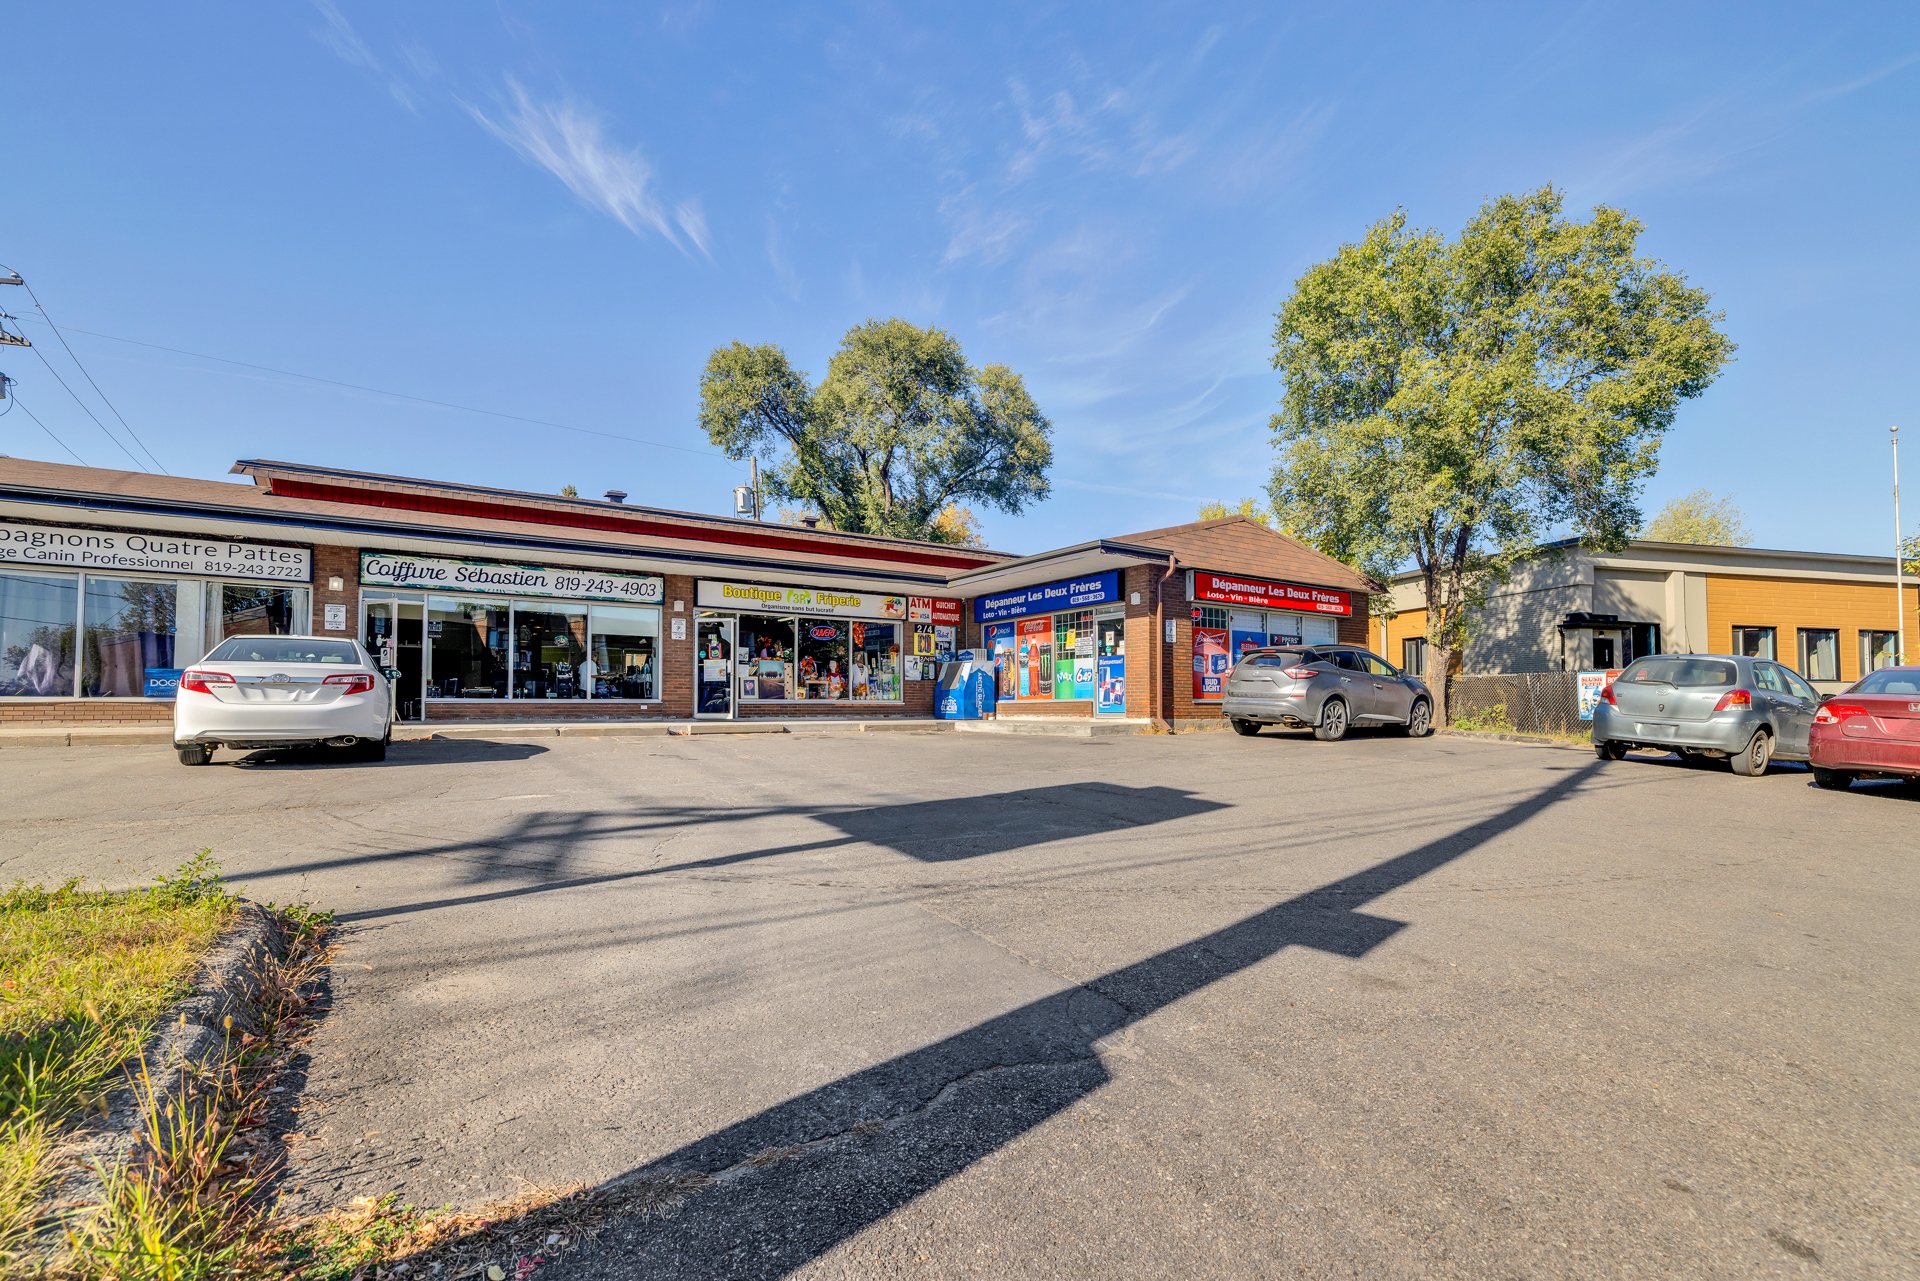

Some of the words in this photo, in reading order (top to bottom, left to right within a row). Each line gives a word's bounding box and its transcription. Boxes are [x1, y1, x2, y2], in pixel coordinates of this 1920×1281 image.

[126, 536, 217, 557] Quatre
[228, 544, 303, 563] Pattes
[23, 547, 75, 561] Canin
[82, 551, 193, 570] Professionnel
[267, 565, 302, 577] 2722
[366, 559, 448, 582] Coiffure
[454, 567, 548, 588] Sébastien
[554, 576, 657, 597] 819-243-4903
[723, 585, 781, 602] Boutique
[817, 593, 861, 607] Friperie
[985, 594, 1026, 609] Dépanneur
[1028, 592, 1042, 602] Les
[1044, 587, 1067, 599] Deux
[1070, 581, 1102, 594] Frères
[1207, 591, 1224, 599] Loto
[1249, 595, 1268, 604] Bière
[1212, 578, 1265, 594] Dépanneur
[1268, 585, 1284, 596] Les
[1287, 588, 1310, 600] Deux
[1312, 591, 1340, 603] Frères
[761, 603, 791, 611] Organisme
[910, 597, 931, 609] ATM
[936, 601, 956, 609] GUICHET
[1011, 606, 1026, 614] Bière
[917, 625, 933, 633] 2/4
